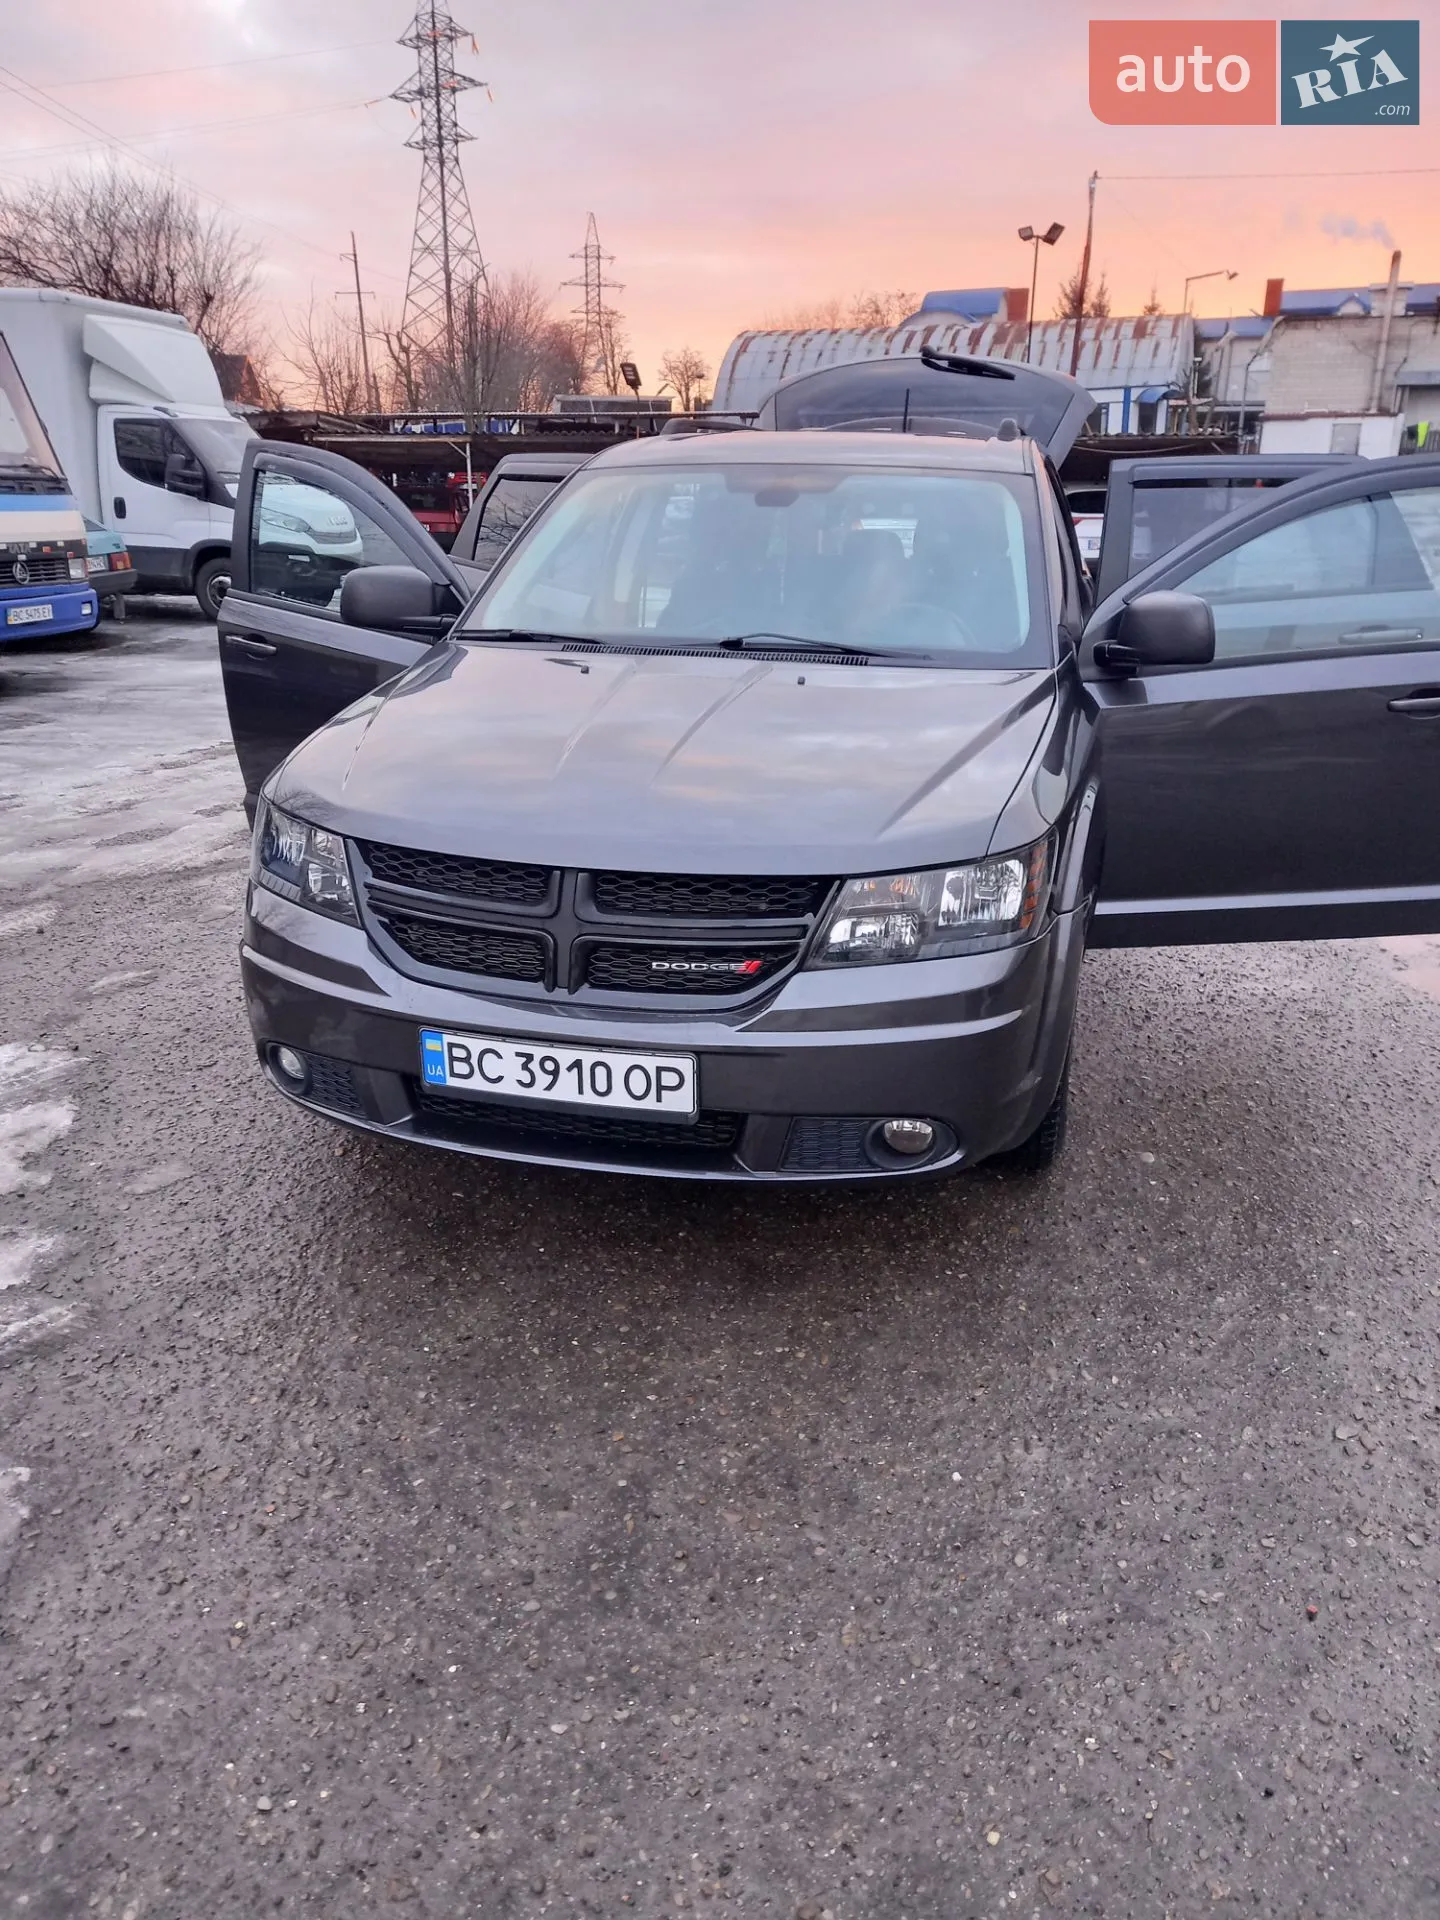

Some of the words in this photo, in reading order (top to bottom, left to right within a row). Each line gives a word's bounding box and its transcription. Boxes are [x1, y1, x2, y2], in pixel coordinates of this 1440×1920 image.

[651, 961, 746, 971] DODGE
[427, 1064, 444, 1077] UA
[446, 1041, 505, 1084] BC
[514, 1051, 613, 1098] 3910
[623, 1063, 686, 1103] OP
